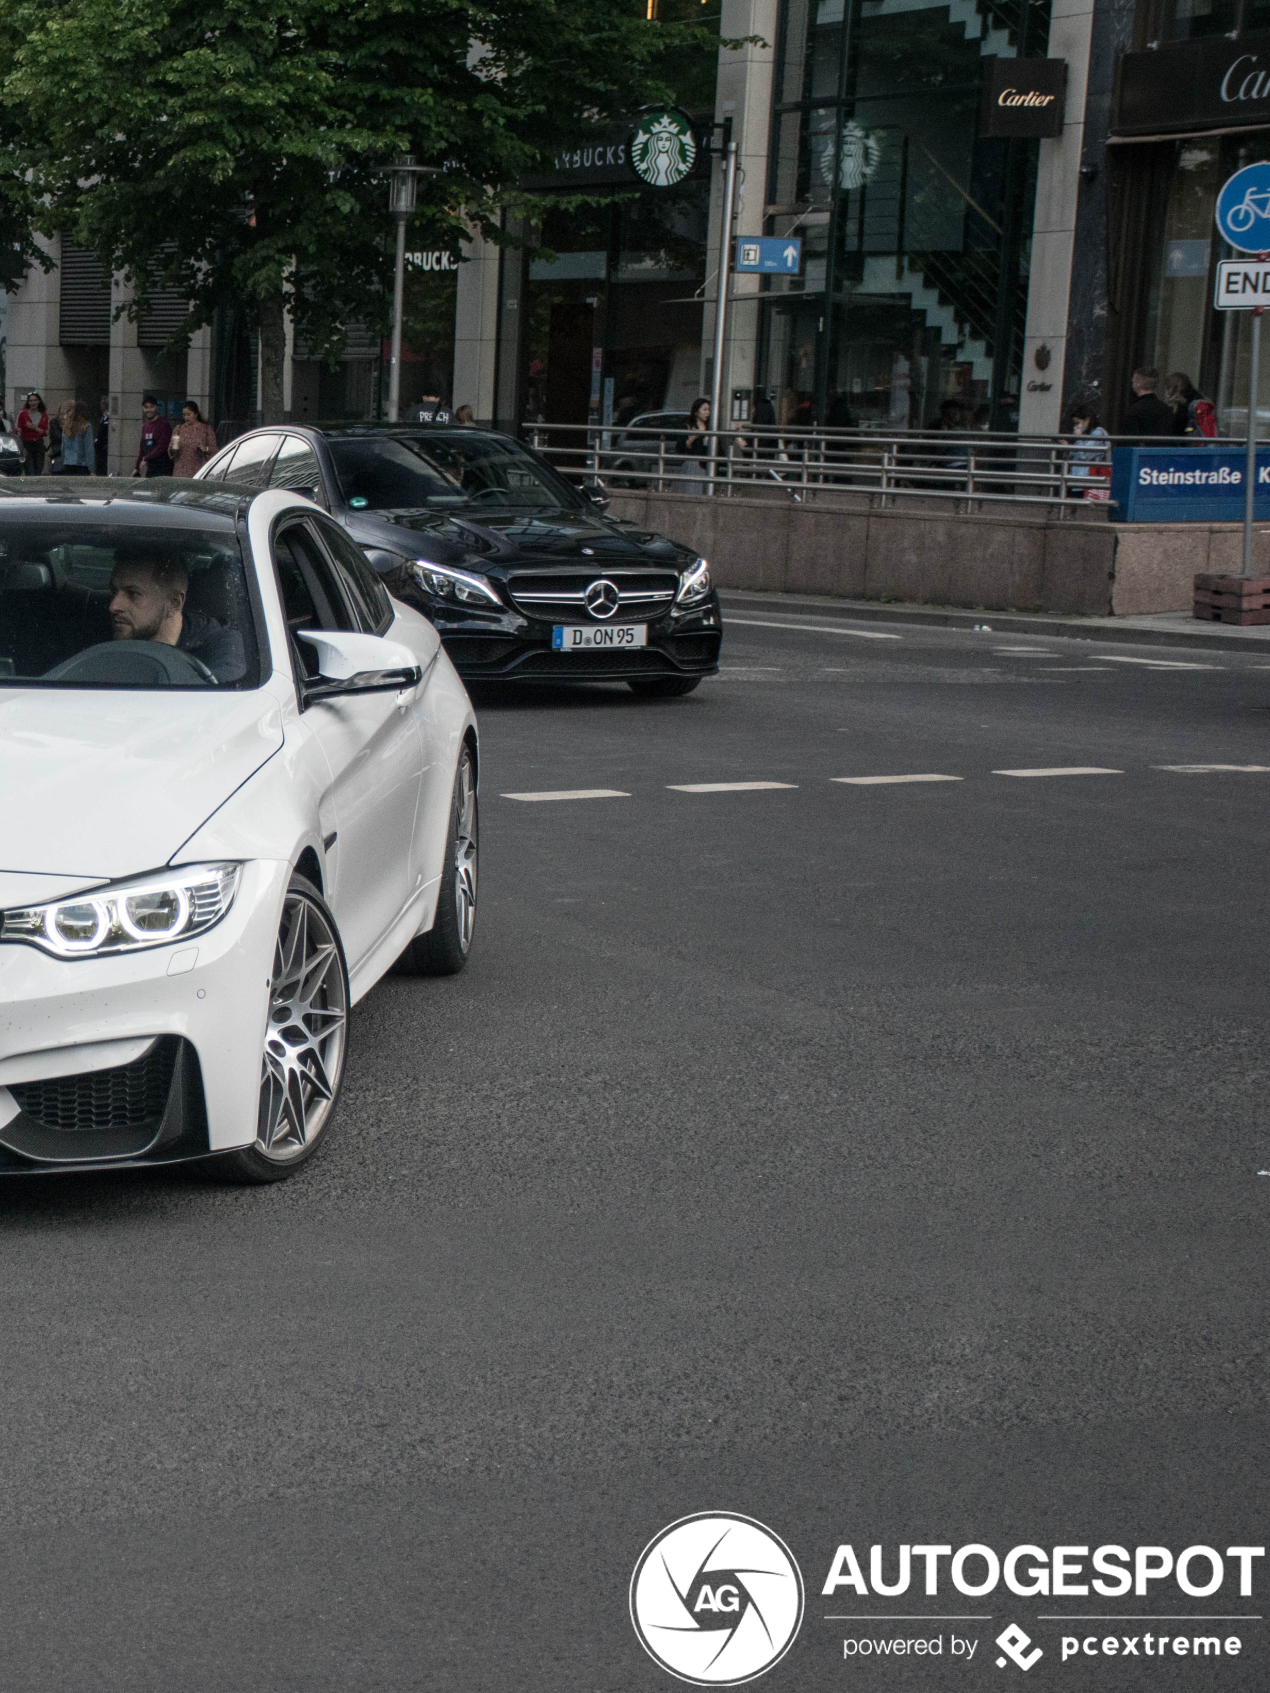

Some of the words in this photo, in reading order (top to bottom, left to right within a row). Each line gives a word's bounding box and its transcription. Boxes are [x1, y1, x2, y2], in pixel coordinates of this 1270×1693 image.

[997, 88, 1056, 107] Cartier
[1138, 466, 1242, 485] Steinstraße
[572, 630, 583, 645] D
[593, 629, 614, 645] ON
[616, 627, 634, 644] 95
